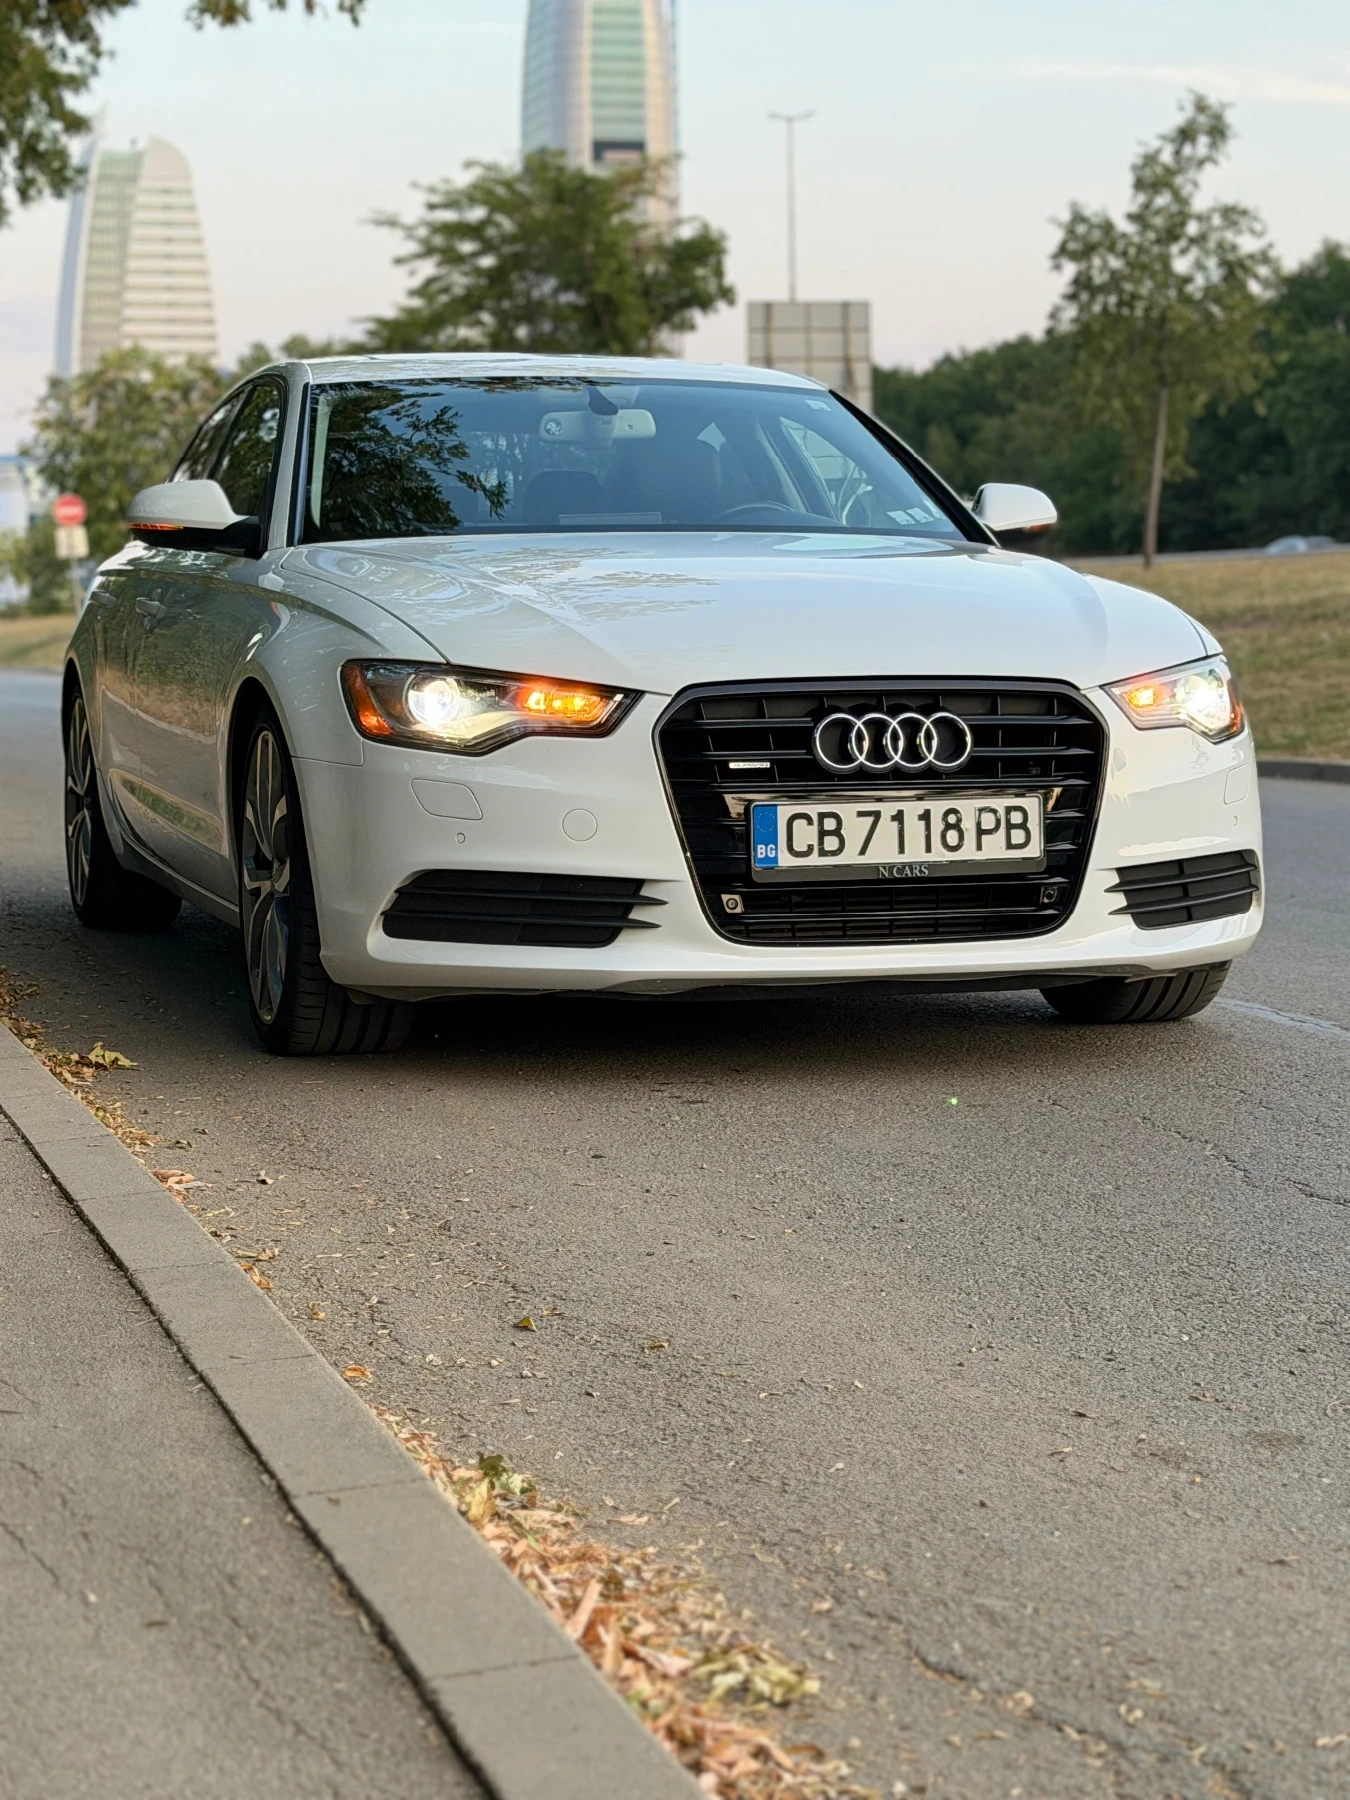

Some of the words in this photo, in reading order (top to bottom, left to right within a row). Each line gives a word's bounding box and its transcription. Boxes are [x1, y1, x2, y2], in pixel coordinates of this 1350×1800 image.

[785, 811, 846, 859] CB
[855, 807, 965, 856] 7118
[974, 805, 1032, 852] PB
[757, 844, 776, 859] BG
[878, 866, 889, 878] N
[892, 864, 929, 878] CARS
